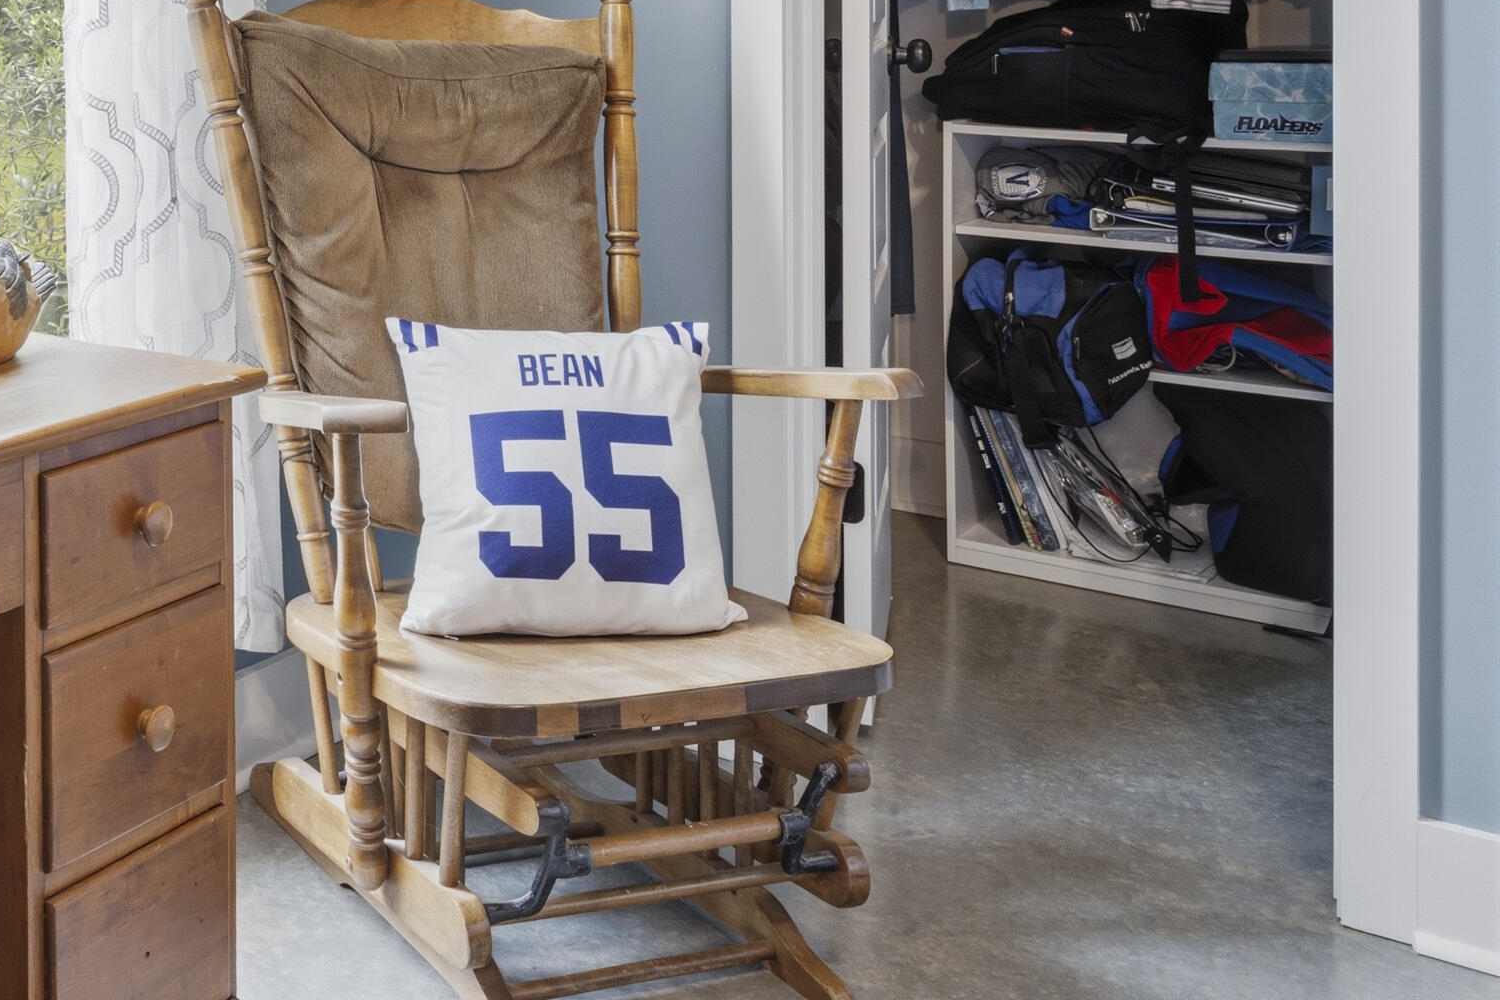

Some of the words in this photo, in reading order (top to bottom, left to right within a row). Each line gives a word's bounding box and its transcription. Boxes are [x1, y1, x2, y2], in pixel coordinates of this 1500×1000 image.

[1236, 113, 1324, 132] FLOAFERS
[1005, 171, 1030, 187] V
[518, 353, 604, 388] BEAN
[468, 409, 686, 586] 55
